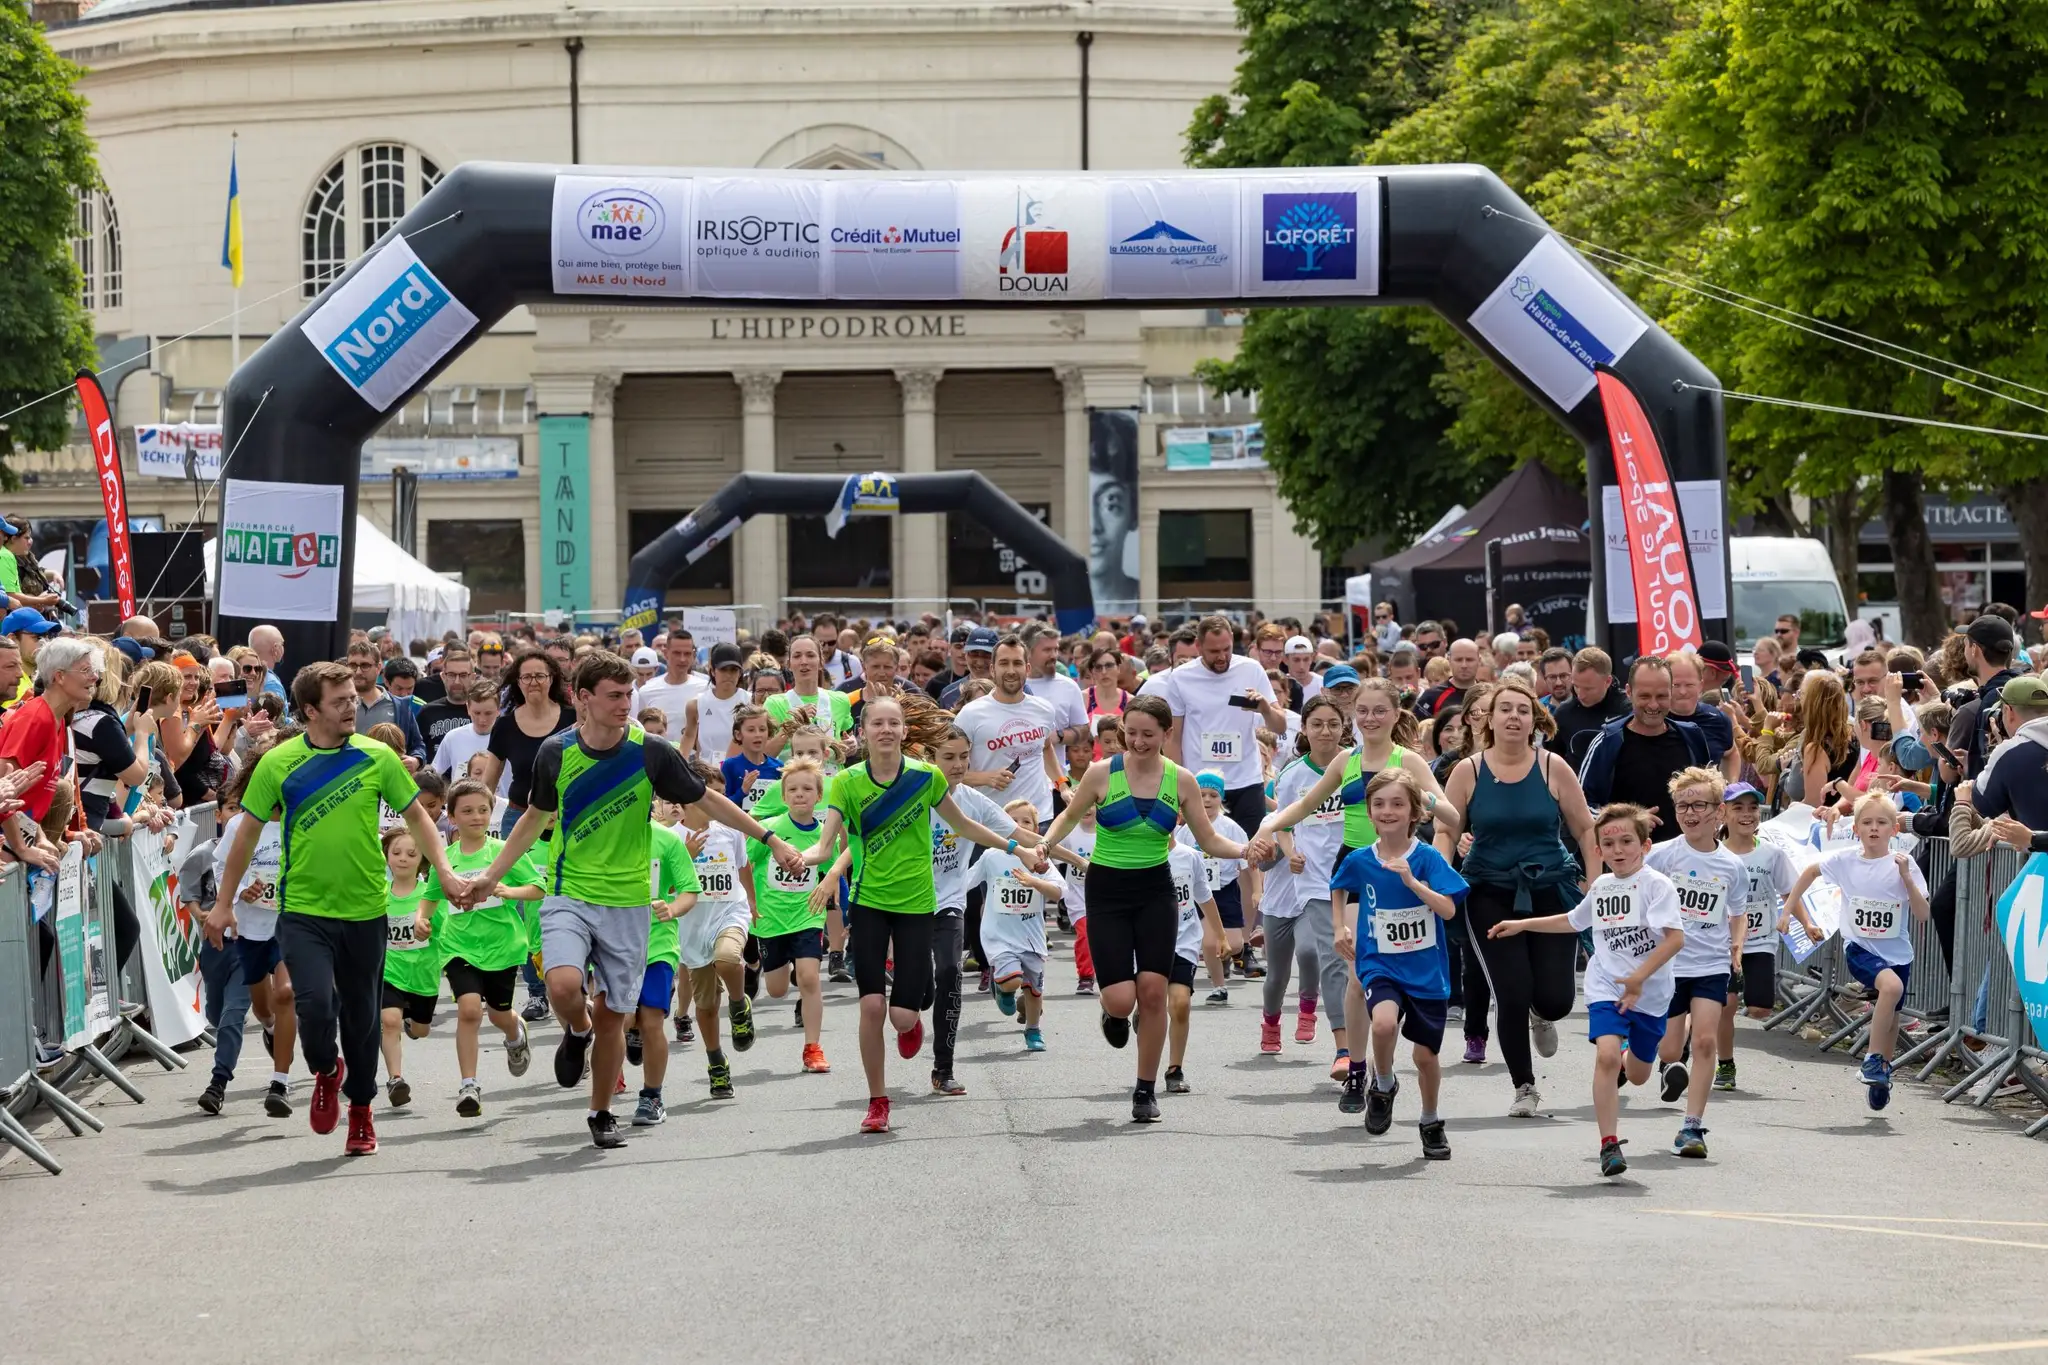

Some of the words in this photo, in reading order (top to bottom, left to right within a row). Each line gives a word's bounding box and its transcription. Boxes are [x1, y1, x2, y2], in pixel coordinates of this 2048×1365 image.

[592, 223, 643, 242] mae
[697, 216, 819, 245] IRISOPTIC
[831, 227, 882, 243] Crédit
[903, 228, 961, 243] Mutuel
[697, 246, 748, 260] optique
[753, 248, 760, 257] &
[765, 247, 820, 259] audition
[1120, 245, 1153, 253] MAISON
[1170, 244, 1217, 253] CHAUFFAGE
[558, 259, 574, 269] Qui
[576, 261, 597, 269] aime
[600, 260, 622, 271] bien,
[625, 260, 655, 272] protège
[657, 262, 684, 271] bien.
[577, 275, 605, 285] MAE
[610, 275, 628, 286] du
[633, 275, 666, 287] Nord
[1000, 277, 1068, 291] DOUAI
[335, 271, 434, 372] Nord
[1527, 302, 1596, 370] Hauts-de-Franc
[226, 522, 295, 533] SUPERMARCHÉ
[1501, 532, 1537, 546] aint
[1539, 526, 1579, 539] Jean
[226, 533, 336, 565] MATCH
[1211, 741, 1233, 754] 401
[700, 874, 732, 891] 3168
[1001, 889, 1033, 904] 3167
[1677, 888, 1718, 912] 3097
[1392, 909, 1420, 919] IRISOPTIC
[1596, 895, 1631, 918] 3100
[1855, 909, 1893, 928] 3139
[1386, 919, 1426, 941] 3011
[1631, 940, 1657, 957] 2022
